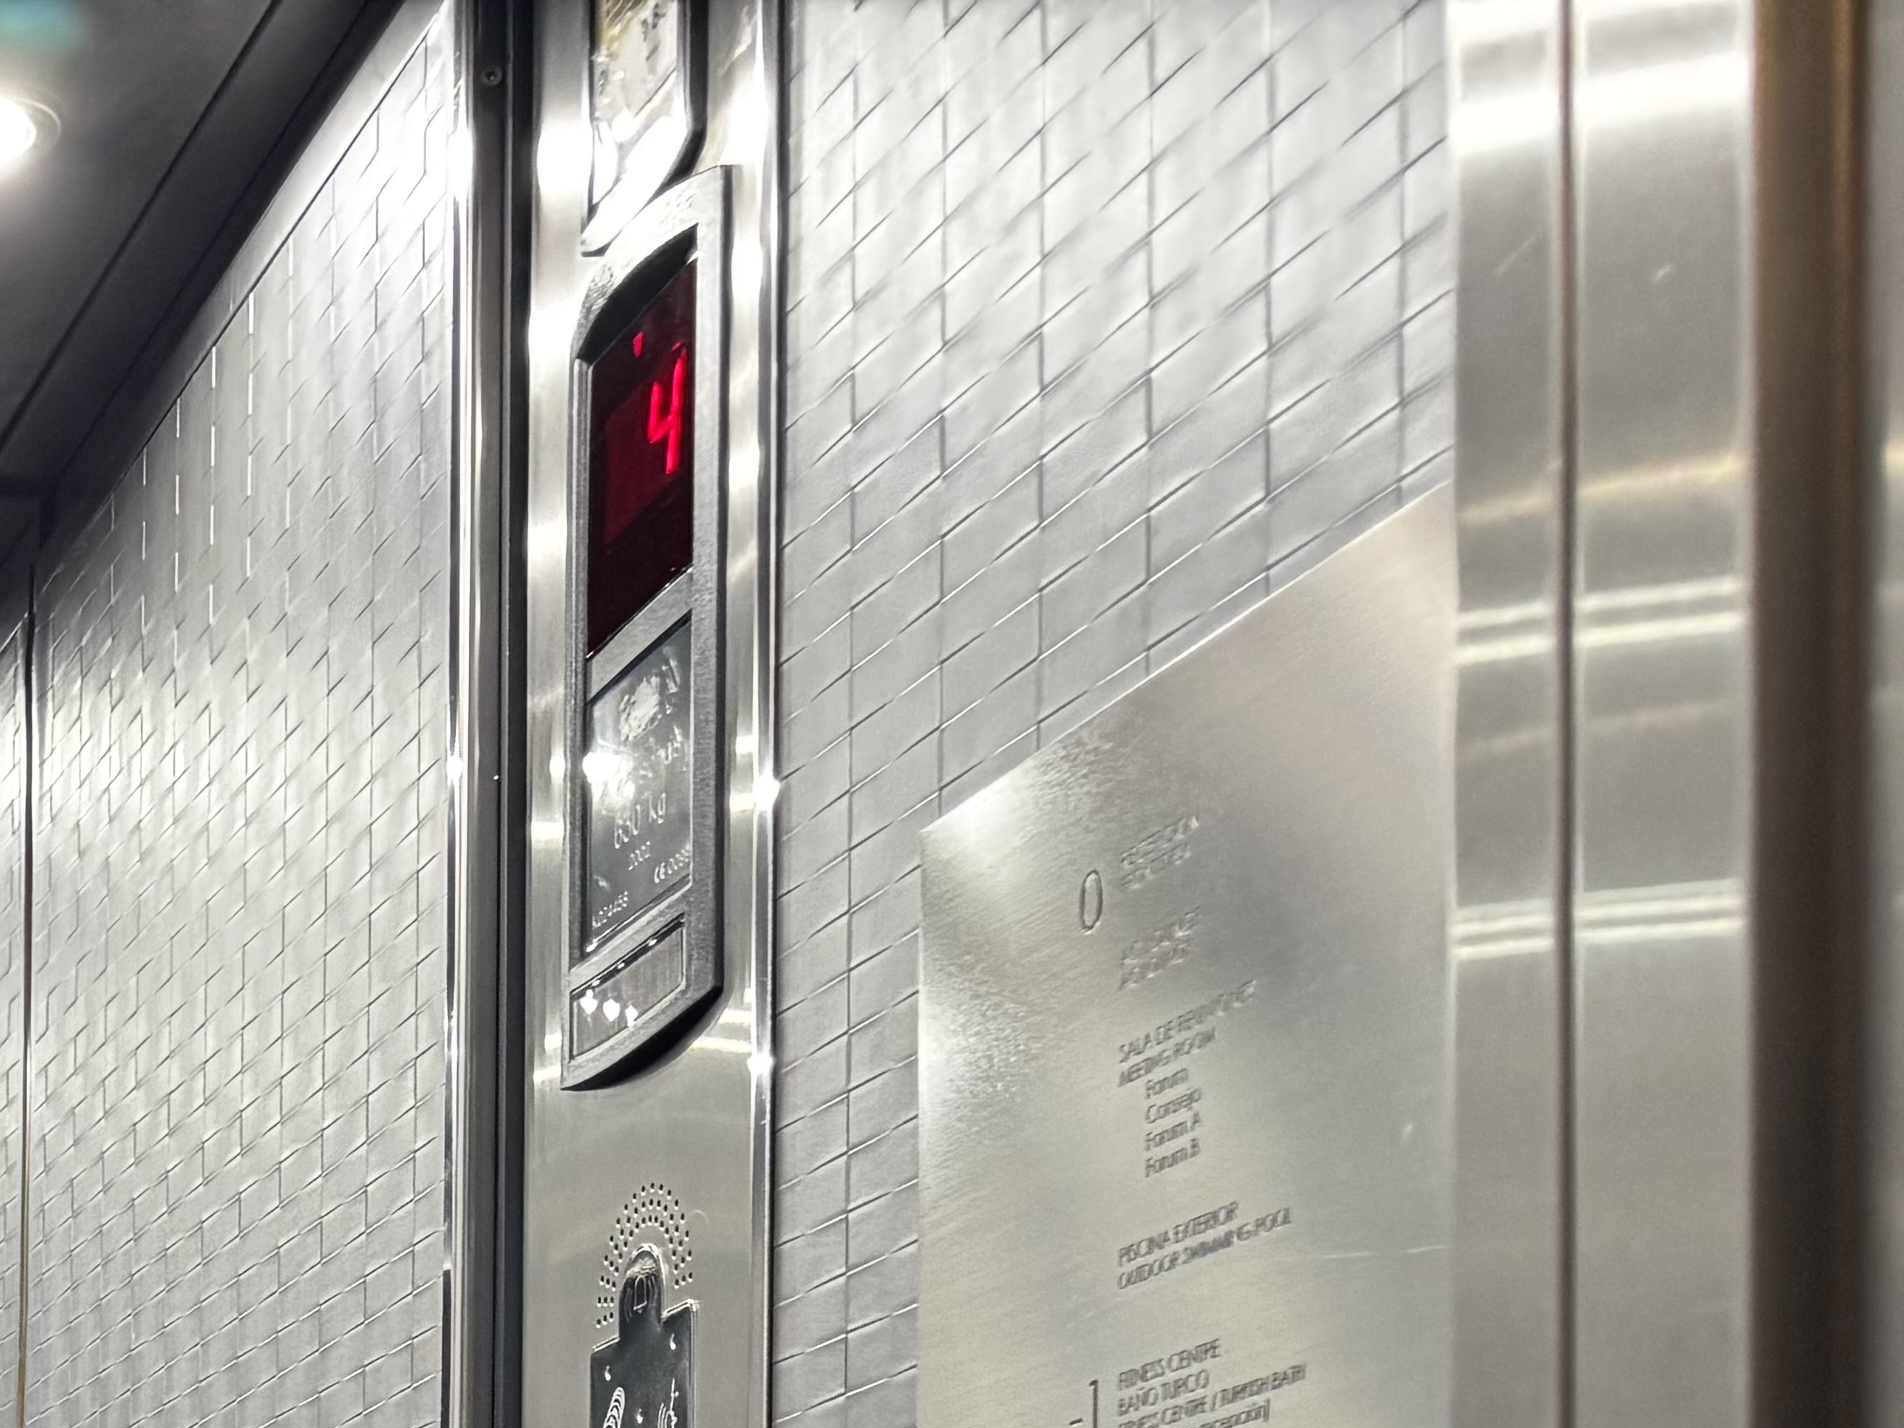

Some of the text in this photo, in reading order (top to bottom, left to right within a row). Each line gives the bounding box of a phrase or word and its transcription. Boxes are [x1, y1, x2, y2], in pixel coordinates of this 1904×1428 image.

[647, 348, 687, 475] 4
[1079, 869, 1103, 931] 0
[1118, 1032, 1153, 1065] SALA
[1154, 1020, 1174, 1047] DE
[1144, 1086, 1202, 1124] Consejo
[1118, 1200, 1240, 1267] PISCINA EXTERIOR
[1117, 1337, 1220, 1391] FITNESS CENTRE
[1117, 1369, 1210, 1417] BAÑO TURCO
